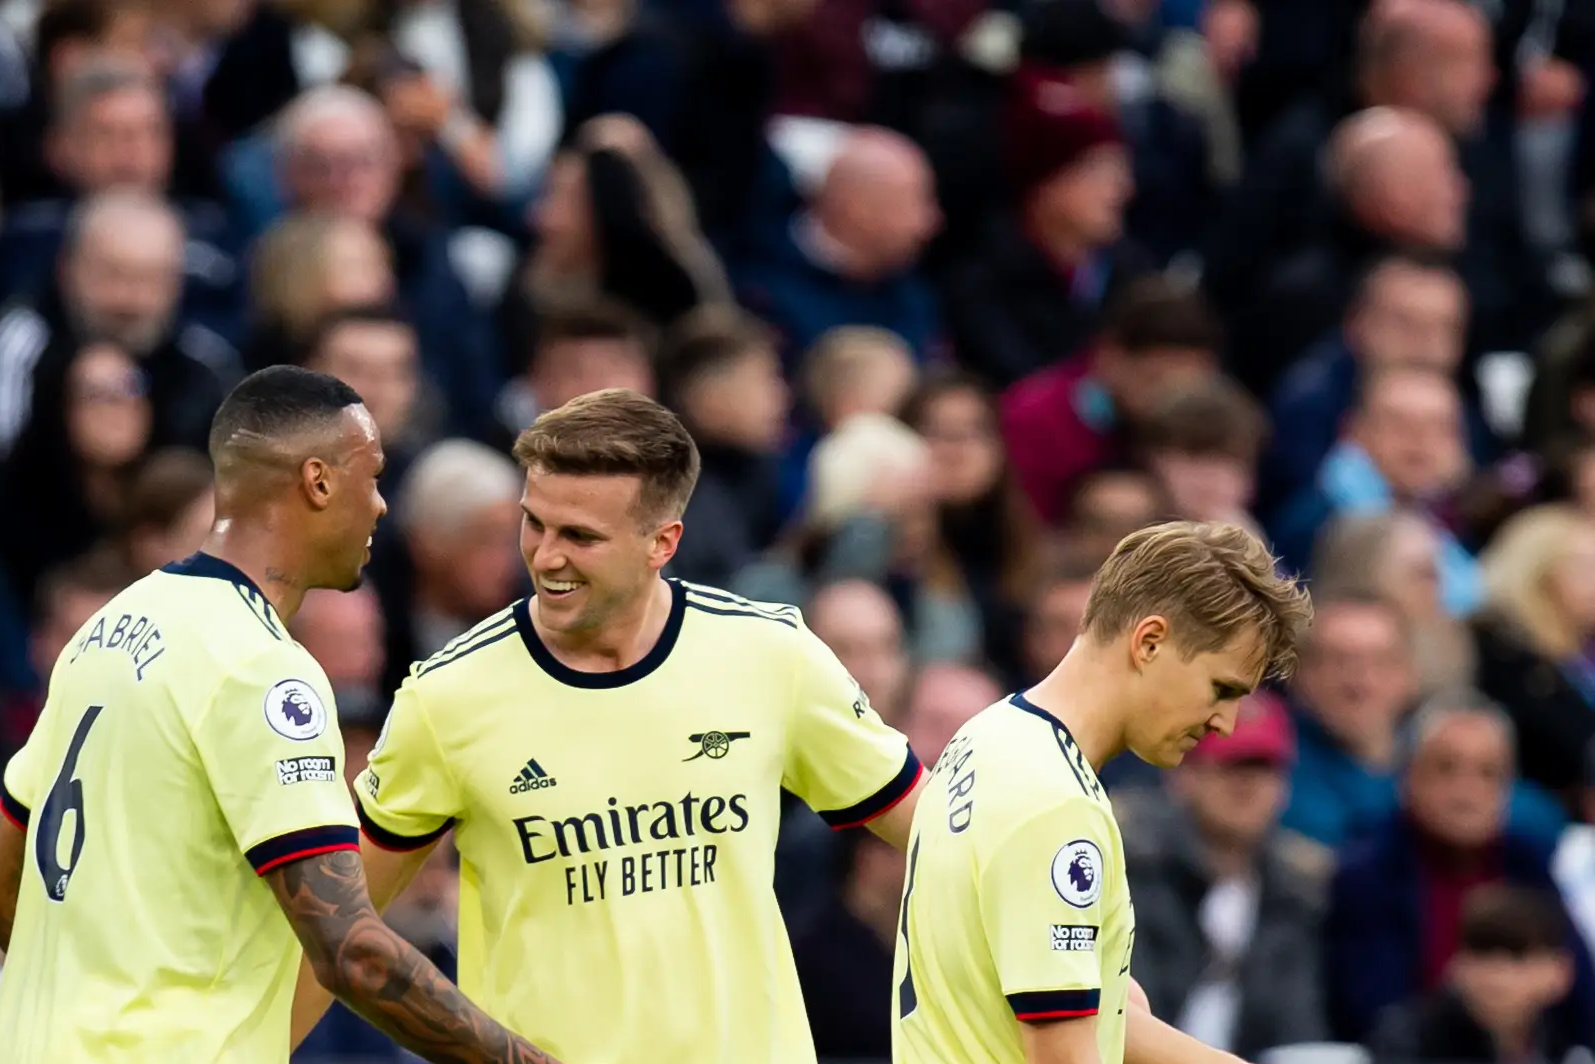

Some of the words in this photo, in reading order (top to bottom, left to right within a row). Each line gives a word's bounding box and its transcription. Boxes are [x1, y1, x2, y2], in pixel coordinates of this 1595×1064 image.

[34, 704, 104, 902] 6
[509, 776, 557, 794] adidas
[512, 791, 749, 864] Emirates
[565, 861, 607, 905] FLY
[622, 844, 717, 896] BETTER
